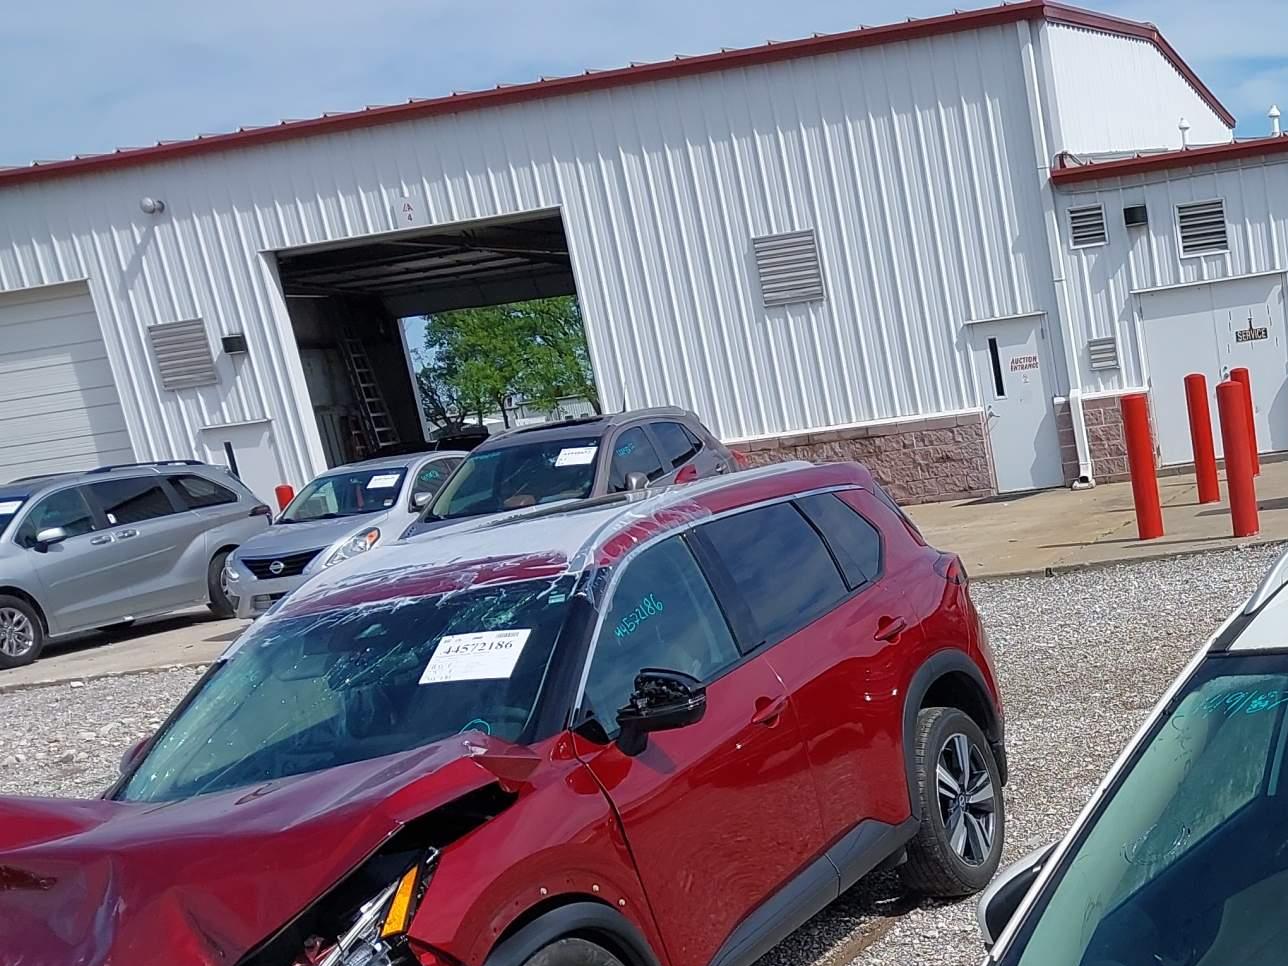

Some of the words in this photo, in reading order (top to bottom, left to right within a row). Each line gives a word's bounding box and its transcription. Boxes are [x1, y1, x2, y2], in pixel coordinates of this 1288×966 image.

[1237, 328, 1267, 342] SERVICE
[1011, 356, 1037, 365] AUCTION
[1010, 362, 1039, 372] ENTRANCE
[443, 641, 513, 654] 44572186
